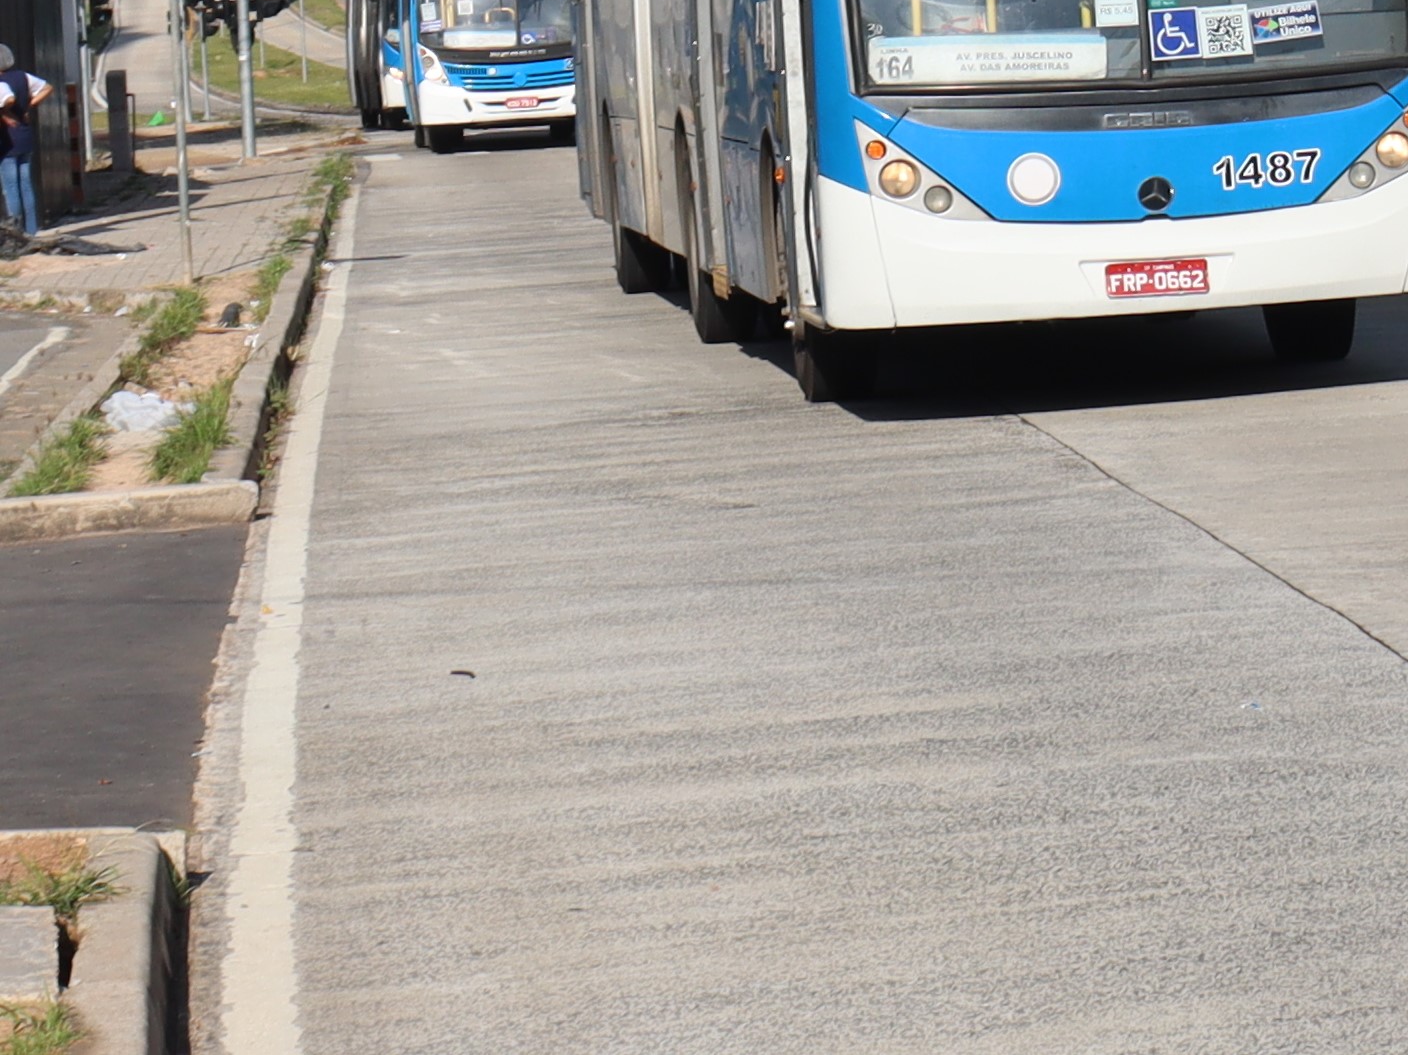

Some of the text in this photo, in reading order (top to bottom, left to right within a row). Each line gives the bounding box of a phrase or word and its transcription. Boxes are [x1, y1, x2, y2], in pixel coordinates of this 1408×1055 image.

[1011, 51, 1073, 60] JUSCELINO
[875, 55, 914, 80] 164
[1005, 62, 1069, 71] AMOREIRAS
[1213, 148, 1321, 191] 1487
